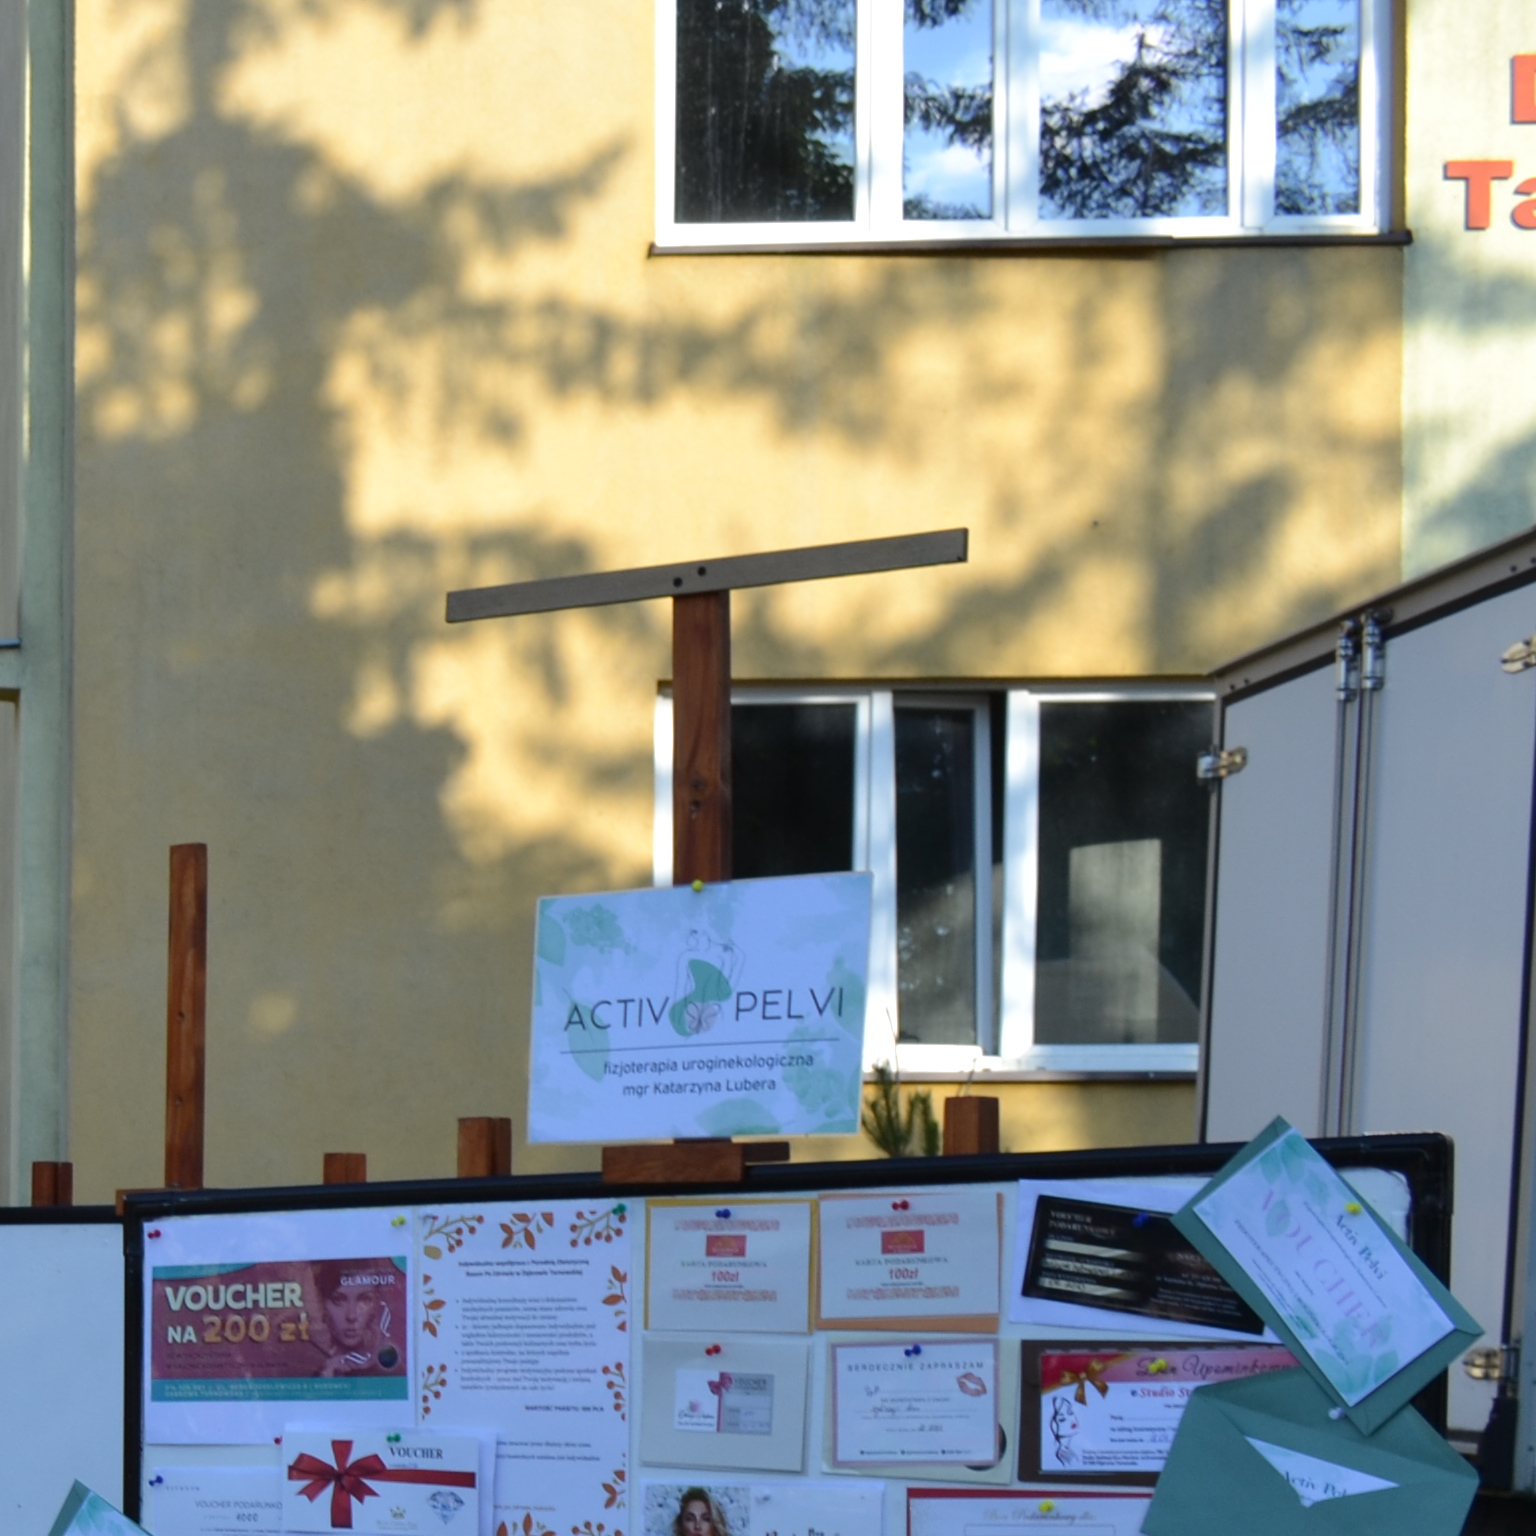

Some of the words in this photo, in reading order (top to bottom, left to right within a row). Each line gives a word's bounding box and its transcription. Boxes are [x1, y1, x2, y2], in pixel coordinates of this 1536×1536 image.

[564, 996, 670, 1032] ACTIV
[735, 986, 844, 1021] PELVI
[604, 1059, 678, 1077] fizjoterapia
[682, 1053, 814, 1074] uroginekologiczna
[623, 1084, 648, 1097] mgr
[653, 1081, 722, 1098] Katarzyna
[726, 1078, 777, 1093] Lubera
[340, 1274, 396, 1286] GLAMOUR
[164, 1282, 305, 1312] VOUCHER
[167, 1325, 197, 1345] NA
[202, 1313, 271, 1344] 200
[280, 1312, 311, 1342] zł
[847, 1362, 914, 1373] SERDECZNIE
[920, 1360, 984, 1371] ZAPRASZAM
[389, 1446, 444, 1460] VOUCHER
